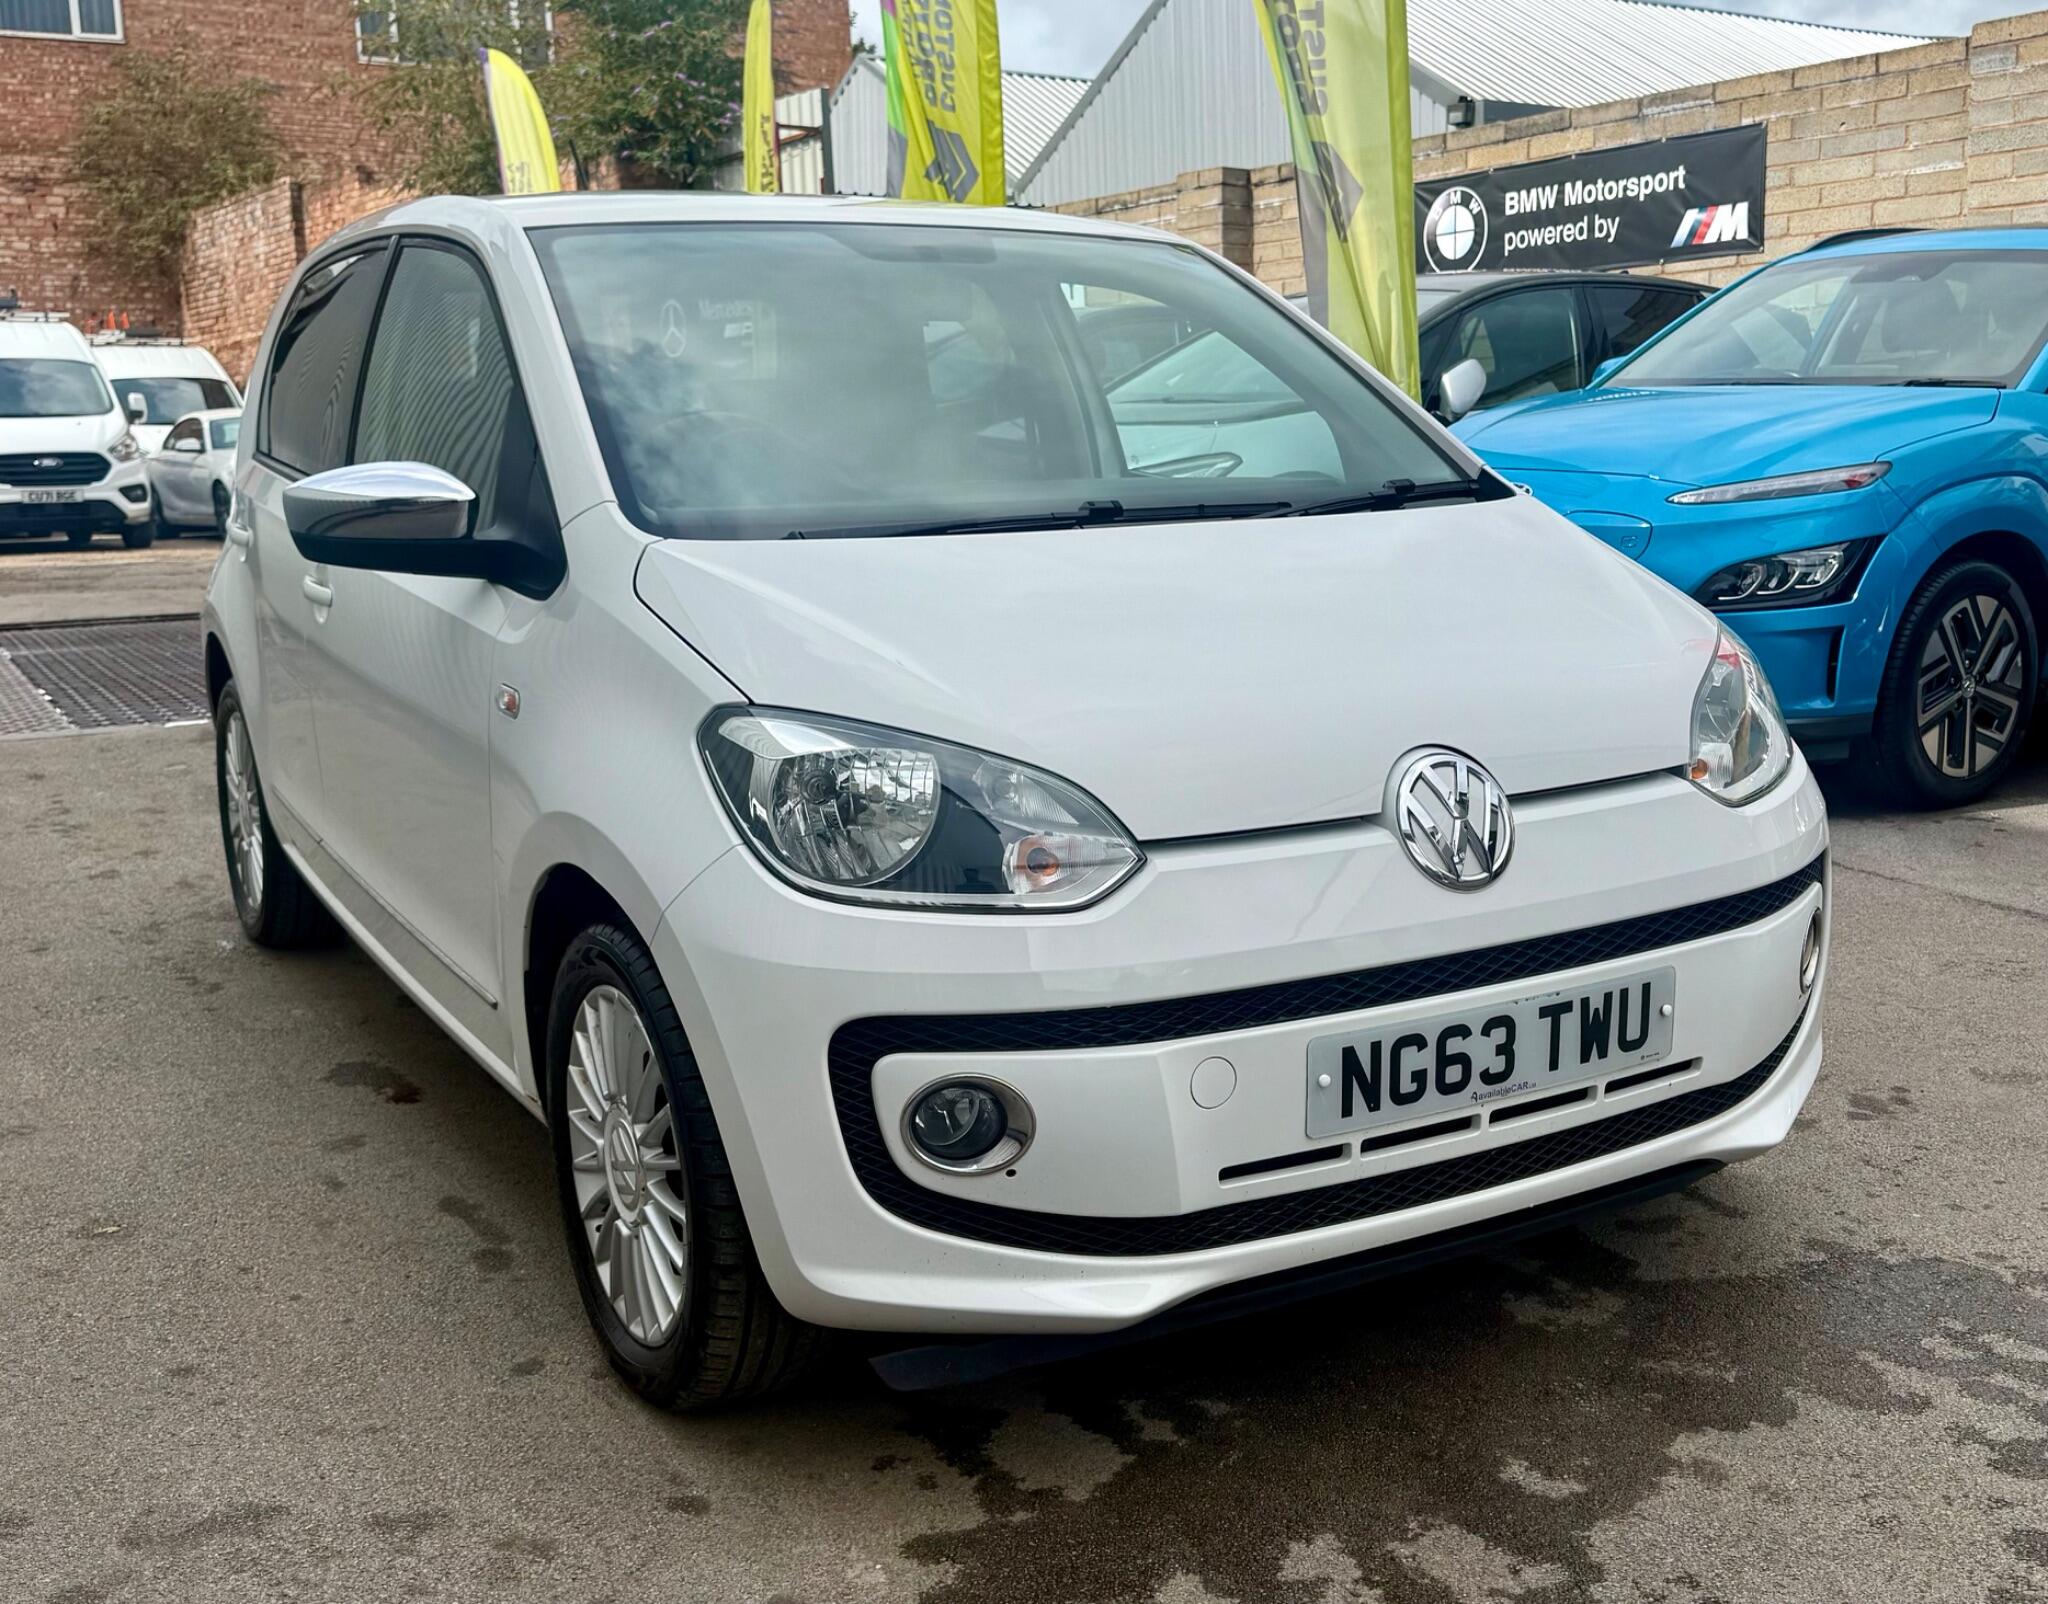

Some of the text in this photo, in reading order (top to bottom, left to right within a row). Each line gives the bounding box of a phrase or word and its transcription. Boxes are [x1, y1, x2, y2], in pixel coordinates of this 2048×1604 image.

[1505, 165, 1686, 216] BMW Motorsport
[1504, 214, 1619, 256] powered by
[1341, 982, 1651, 1119] NG63 TWU
